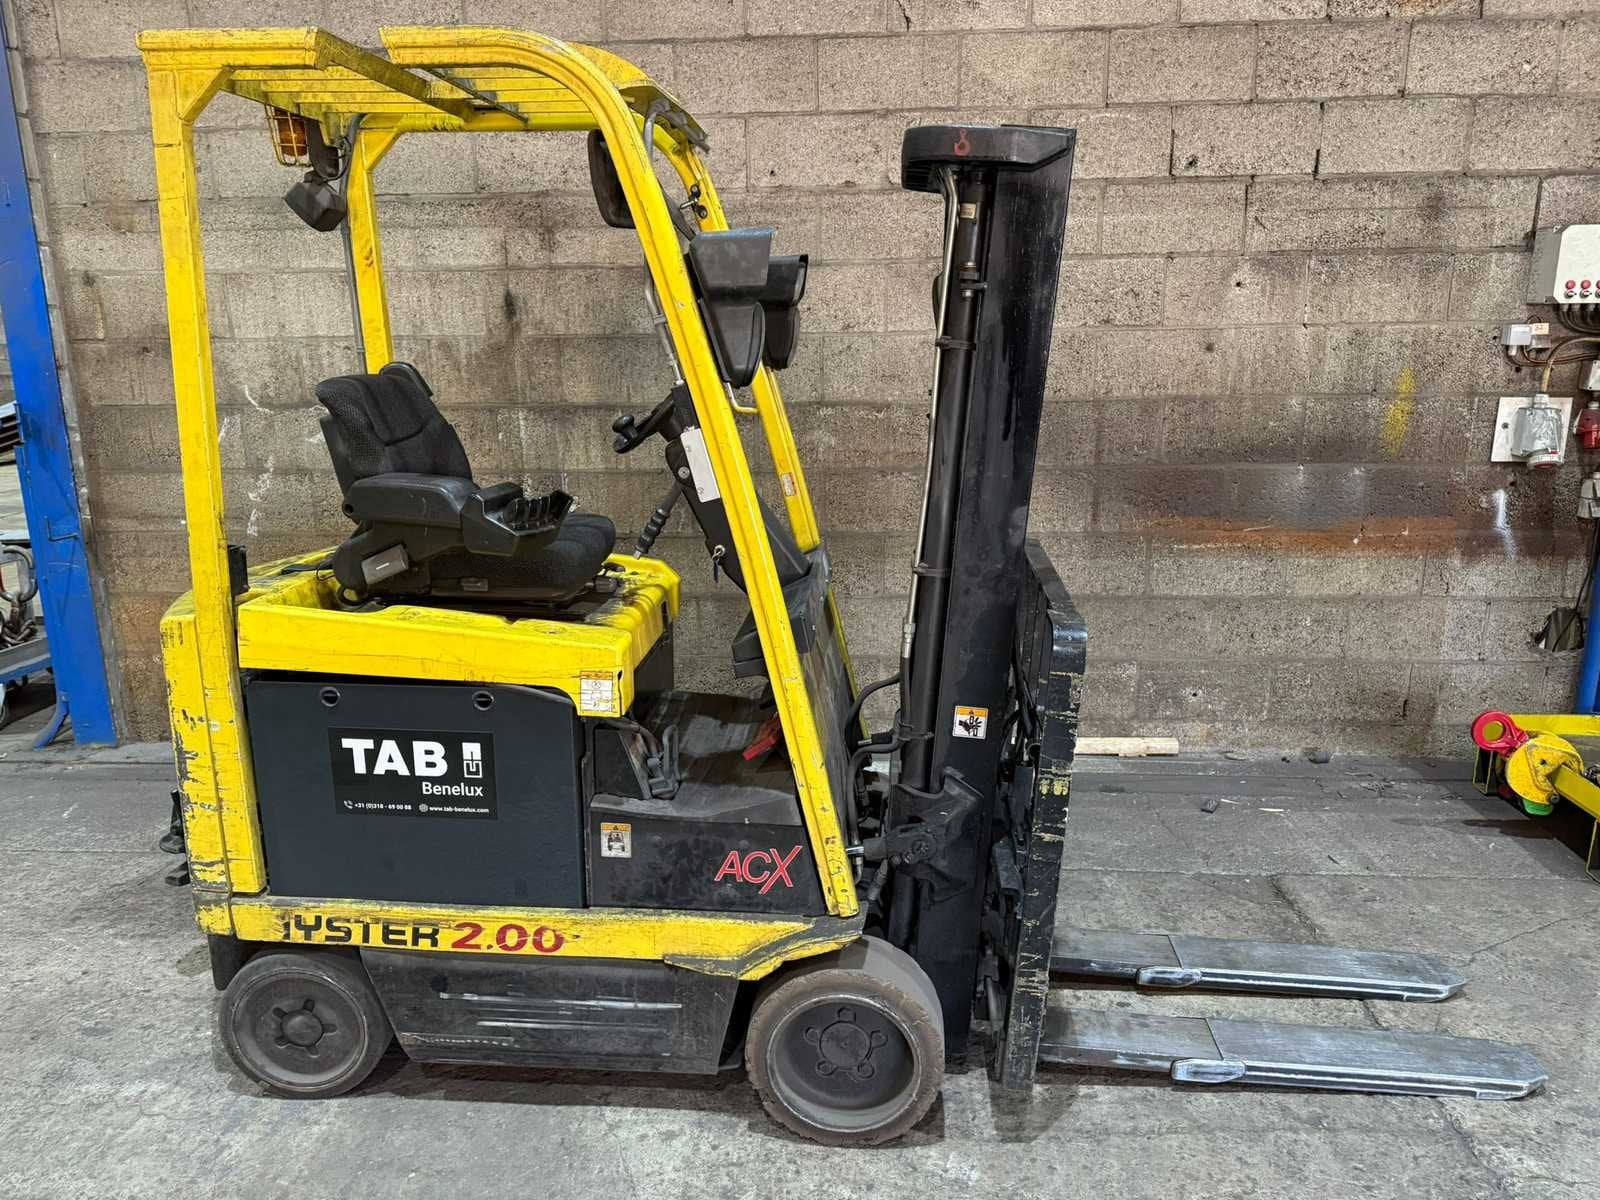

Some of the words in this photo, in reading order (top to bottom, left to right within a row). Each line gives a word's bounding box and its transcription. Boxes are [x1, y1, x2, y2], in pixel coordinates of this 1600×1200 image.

[341, 738, 448, 777] TAB
[422, 781, 483, 797] Benelux
[714, 845, 803, 895] ACX
[451, 921, 565, 953] 2.00
